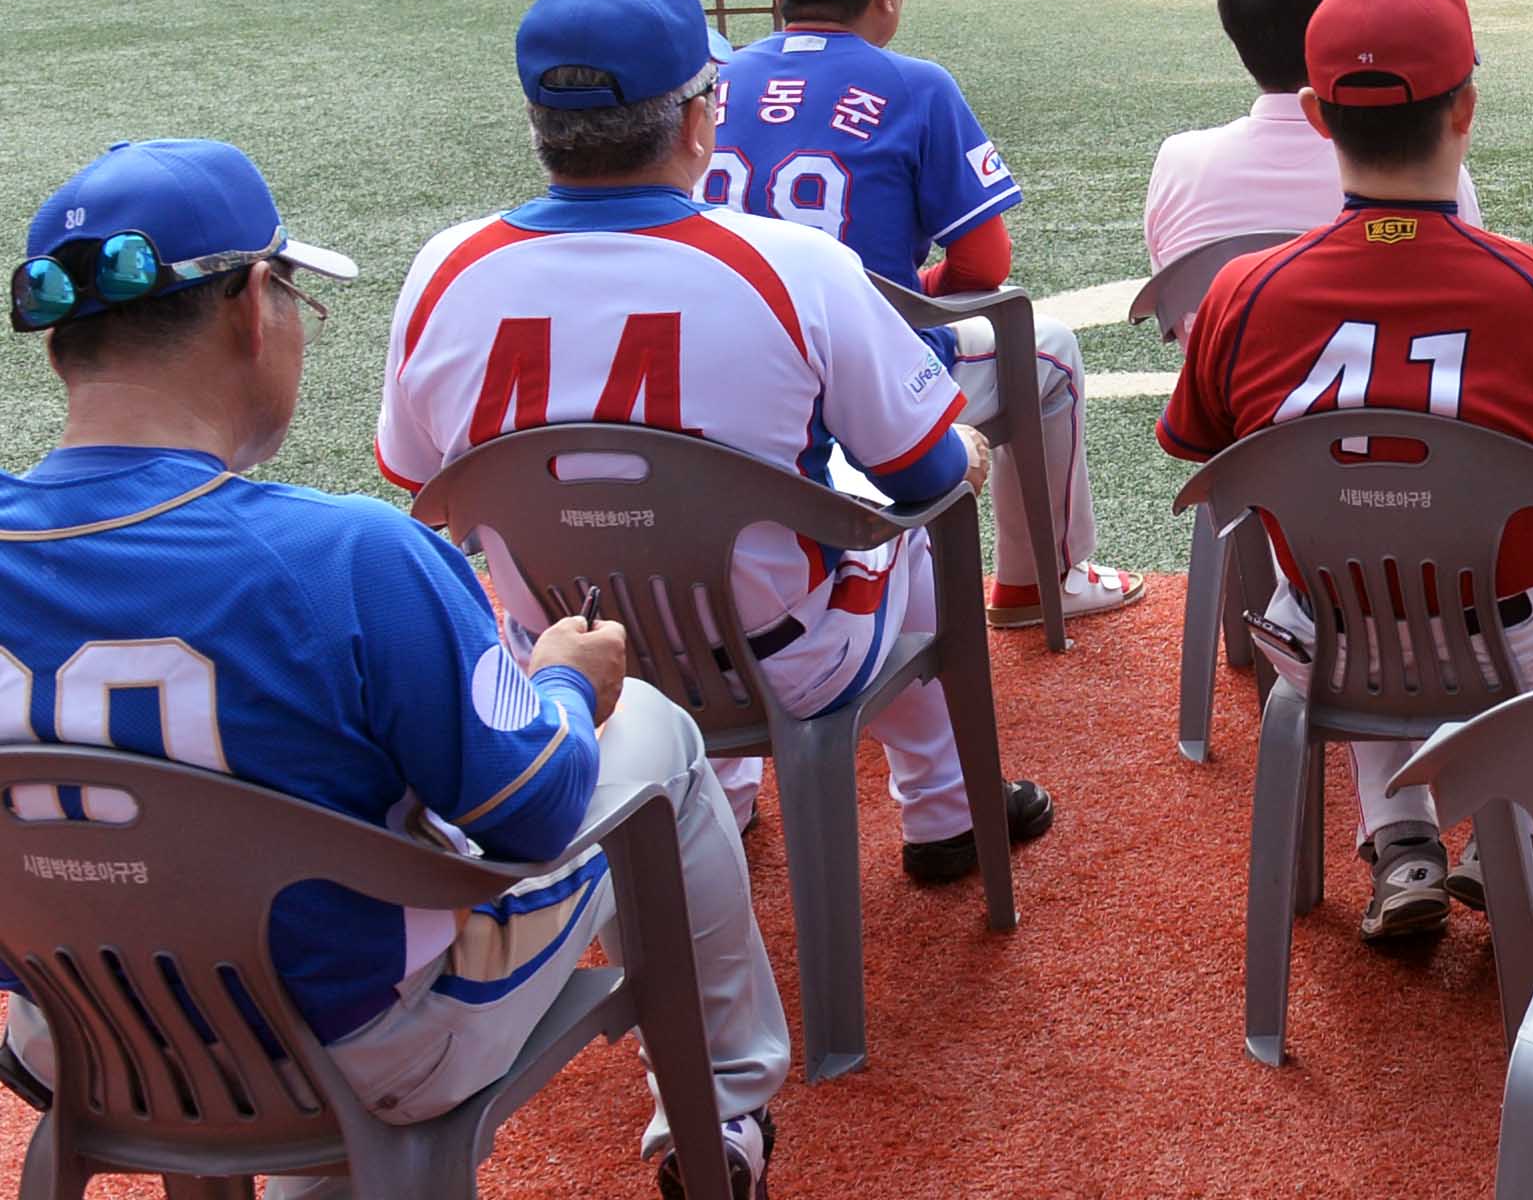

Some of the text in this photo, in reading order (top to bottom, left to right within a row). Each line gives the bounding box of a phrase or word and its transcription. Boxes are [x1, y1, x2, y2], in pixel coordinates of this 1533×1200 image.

[64, 207, 86, 229] 80
[1371, 221, 1414, 236] ZETT
[1272, 319, 1471, 424] 41
